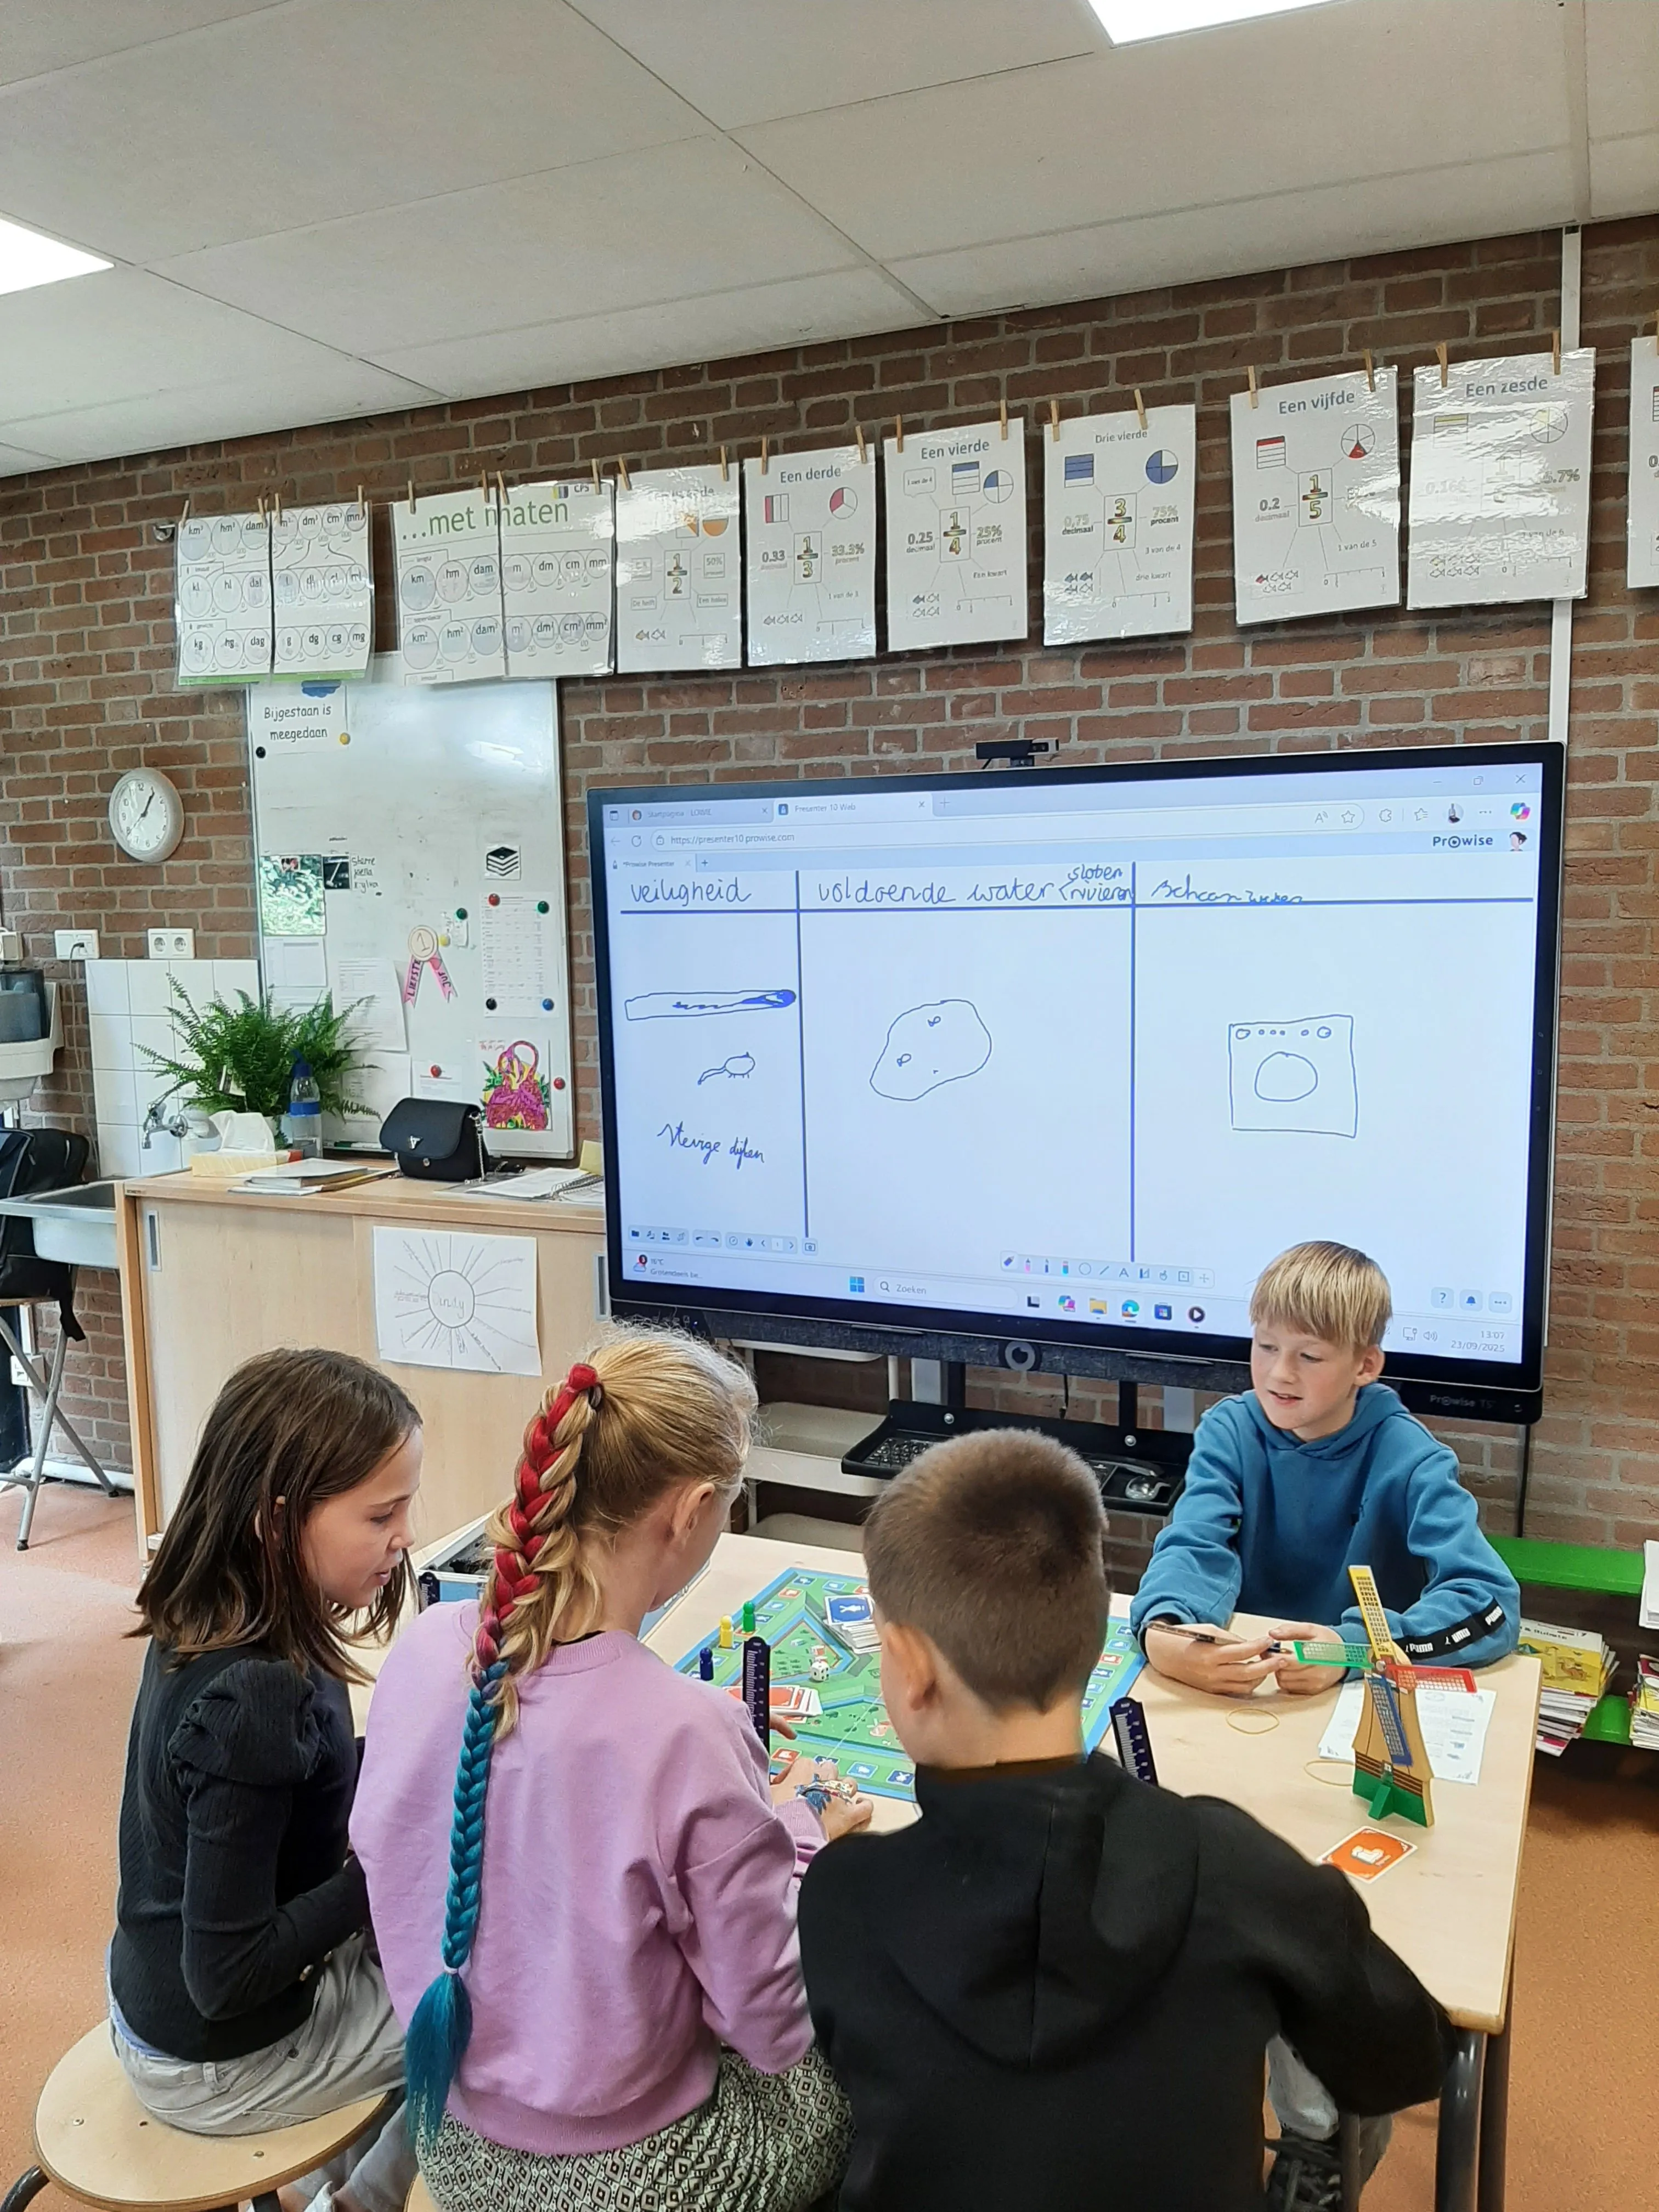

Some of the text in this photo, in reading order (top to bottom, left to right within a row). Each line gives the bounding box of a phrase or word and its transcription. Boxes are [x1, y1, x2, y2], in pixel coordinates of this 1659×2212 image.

[1466, 375, 1548, 397] Een zesde
[1279, 390, 1355, 414] Een vijfde
[1096, 430, 1148, 443] Drie vierde
[921, 439, 990, 459] Een vierde
[781, 465, 840, 483] Een derde
[1309, 475, 1321, 493] 1
[1115, 498, 1126, 517] 3
[1260, 498, 1280, 511] 0.2
[1309, 500, 1321, 519] 5
[950, 511, 960, 529] 1
[908, 532, 933, 545] 0.25
[977, 525, 1002, 539] 25%
[1113, 525, 1126, 543] 4
[803, 536, 813, 554] 1
[949, 537, 960, 555] 4
[411, 575, 424, 583] km
[446, 569, 460, 579] hm
[474, 565, 493, 574] dam
[539, 561, 553, 571] dm
[589, 558, 606, 567] mm
[673, 553, 682, 571] 1
[803, 561, 813, 578] 3
[193, 583, 199, 591] kl
[224, 579, 232, 589] hl
[250, 578, 262, 588] dal
[672, 577, 682, 594] 2
[194, 639, 202, 650] kg
[225, 639, 234, 647] hg
[251, 636, 264, 647] dag
[309, 634, 319, 645] dg
[332, 634, 341, 644] cg
[353, 633, 365, 642] mg
[264, 704, 331, 722] Bijgestaan is
[270, 726, 328, 743] meegedaan
[1432, 834, 1493, 848] Prowise
[630, 877, 752, 907] veiligheid
[967, 877, 1053, 901] water
[896, 1285, 927, 1295] Zoeken
[1451, 1340, 1505, 1352] 23/09/2025
